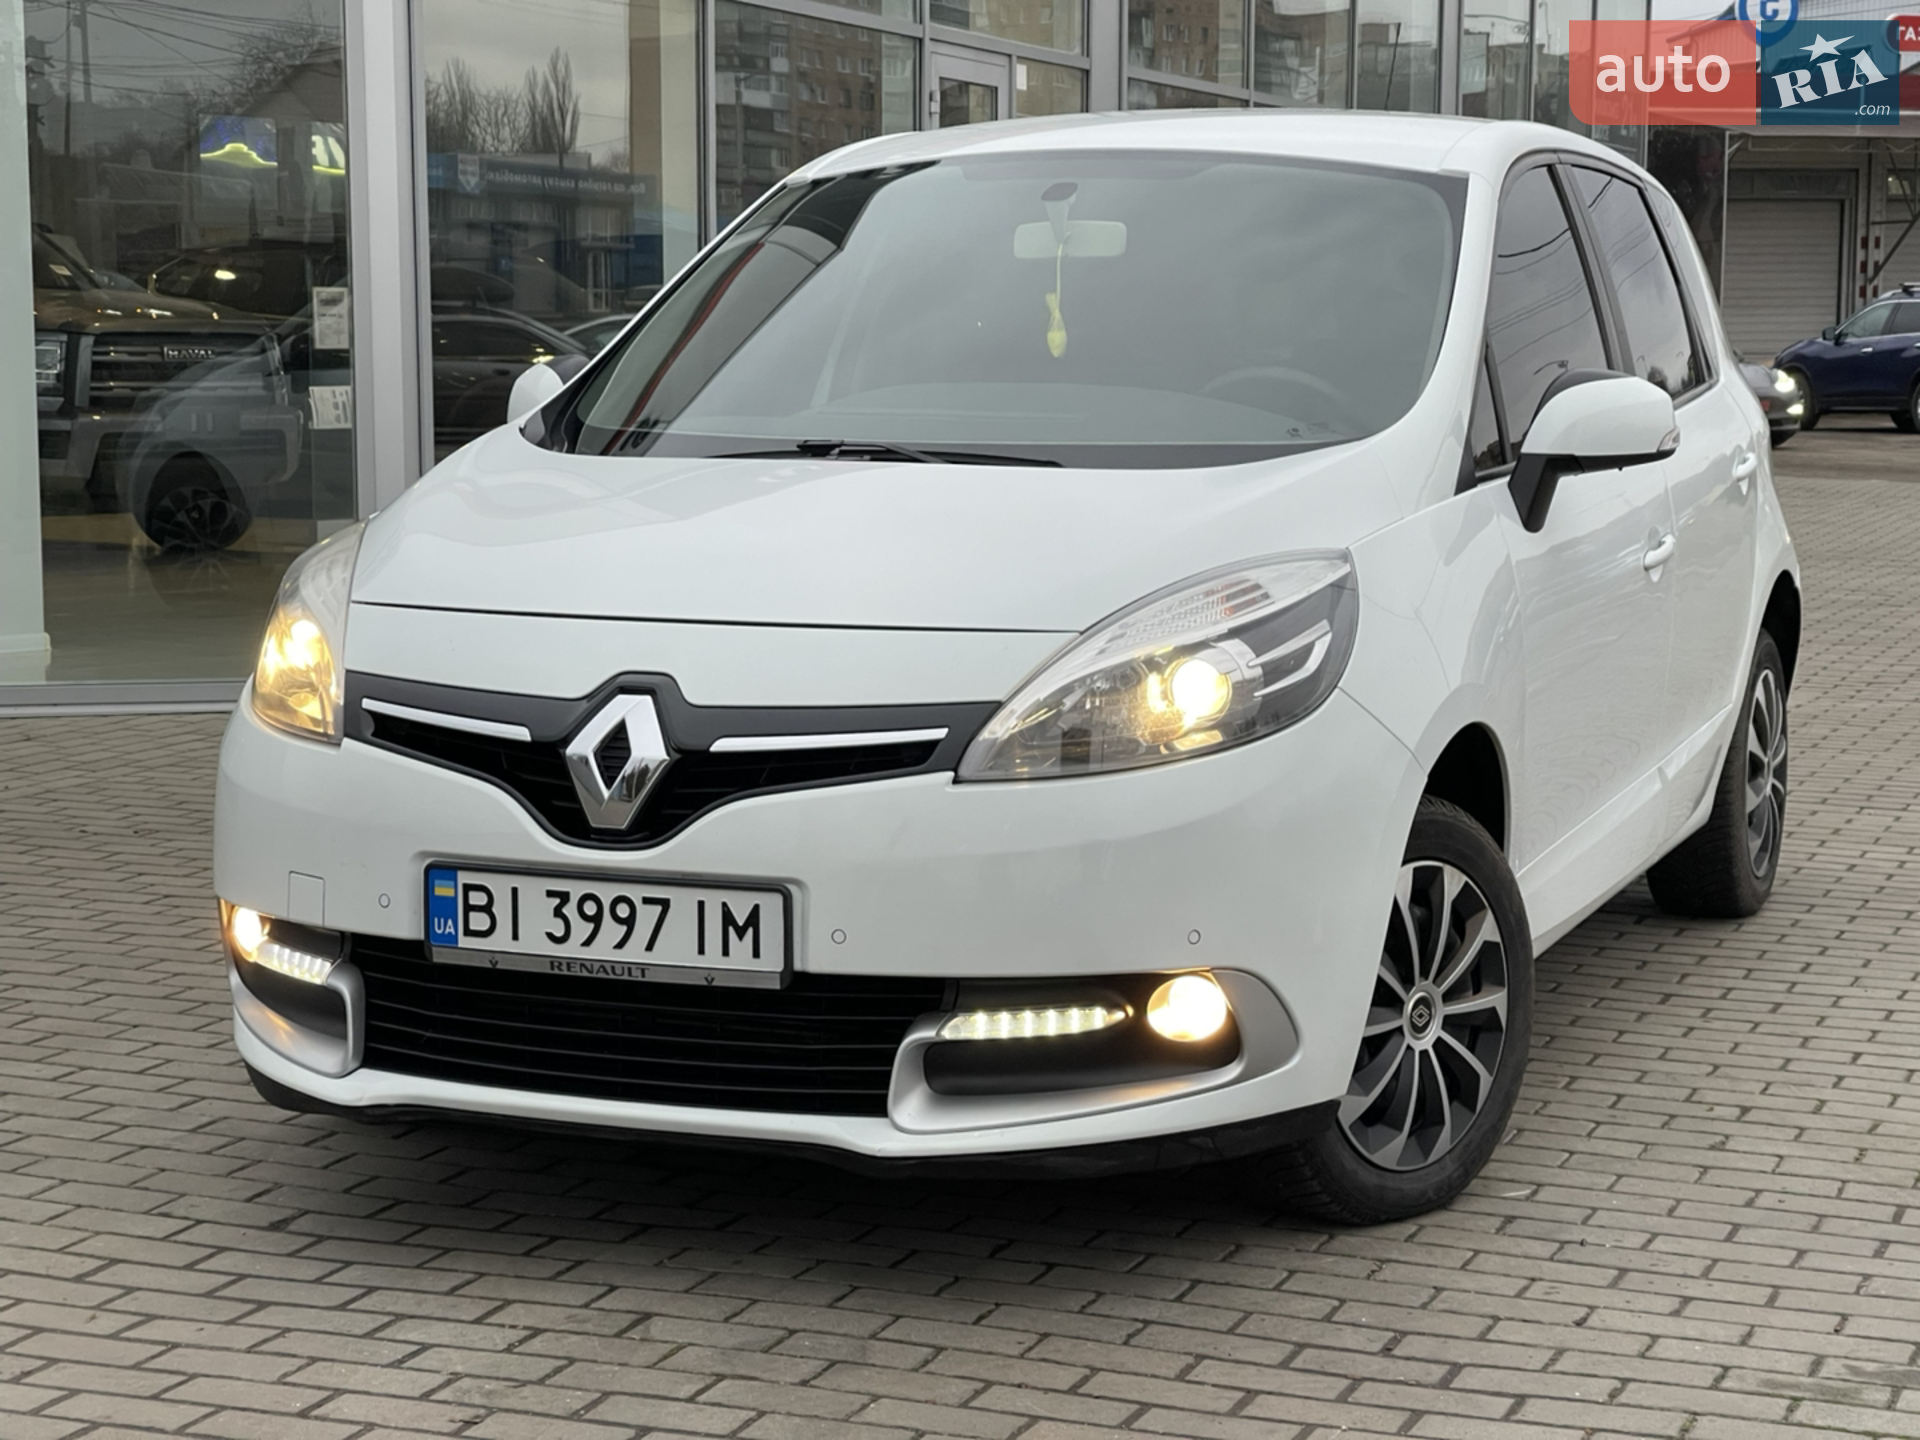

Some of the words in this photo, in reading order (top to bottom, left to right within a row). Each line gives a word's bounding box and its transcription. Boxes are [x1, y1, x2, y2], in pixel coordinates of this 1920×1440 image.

[1896, 26, 1920, 41] ГА
[168, 349, 216, 359] HAVAL
[434, 917, 455, 935] UA
[462, 882, 519, 941] BI
[545, 889, 671, 952] 3997
[697, 900, 761, 959] IM
[549, 960, 650, 979] RENAULT
